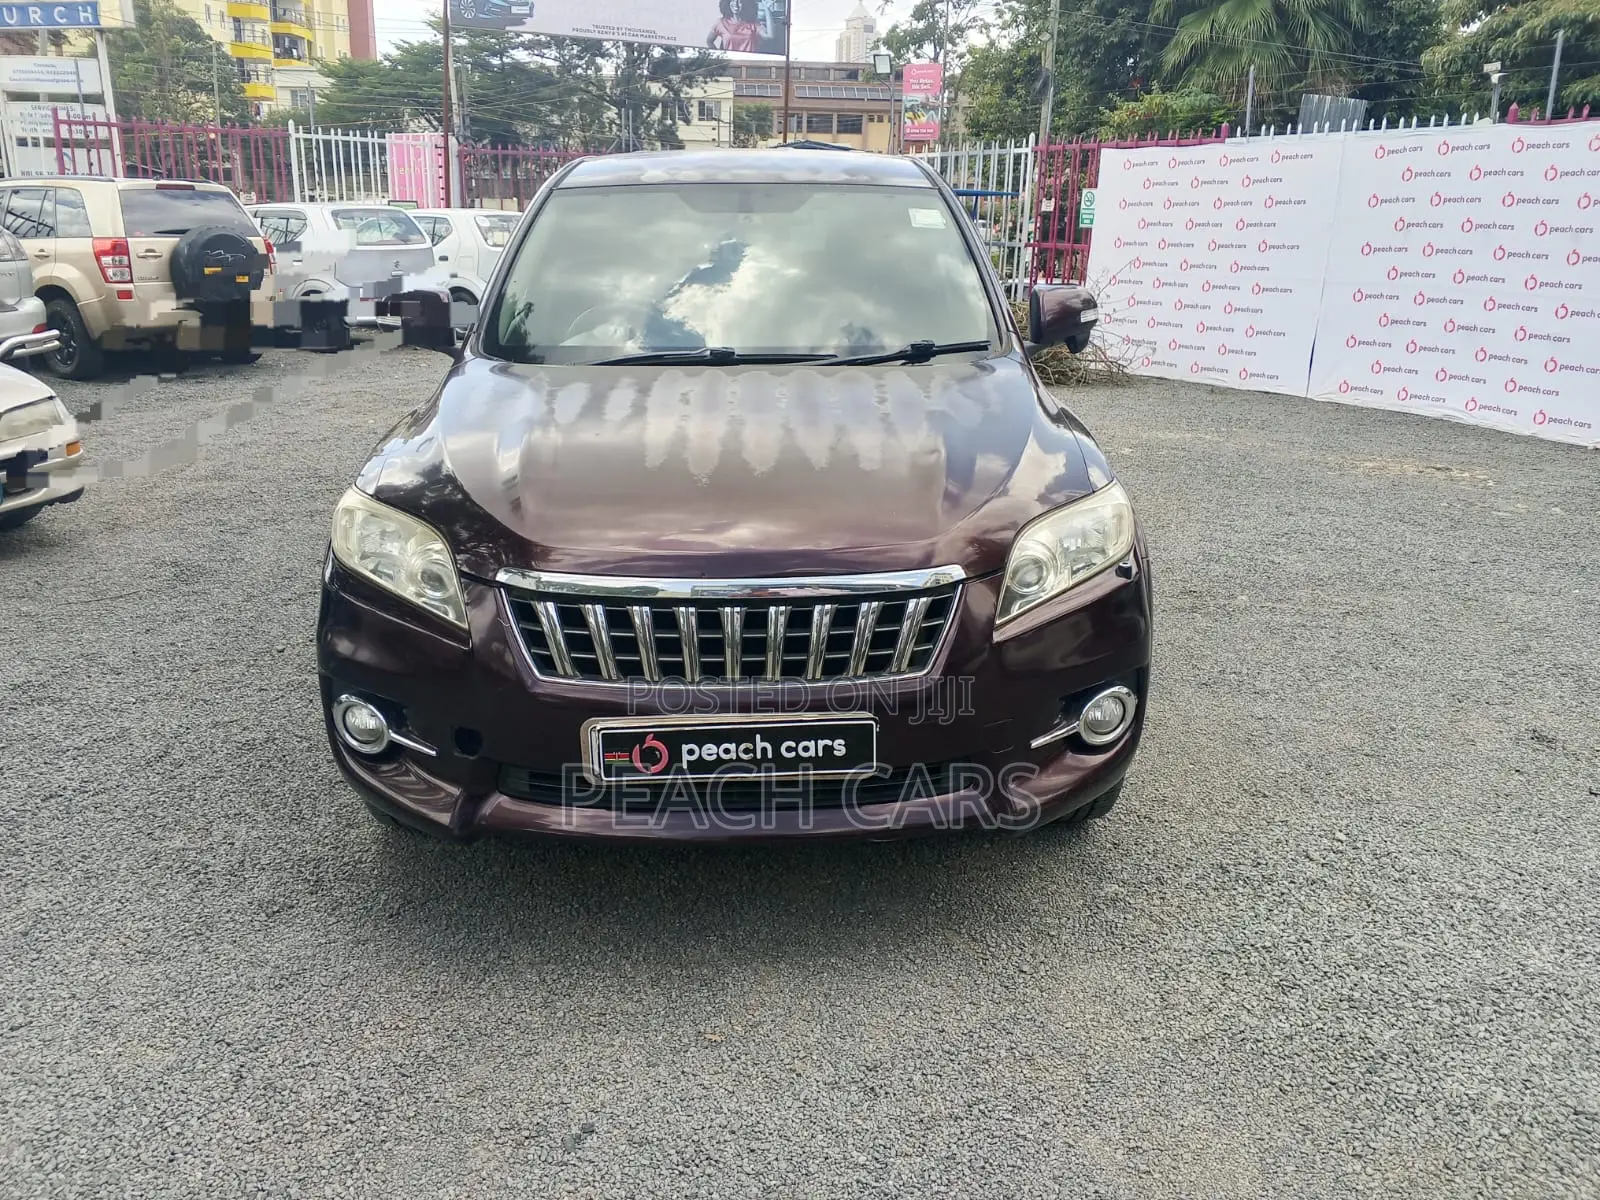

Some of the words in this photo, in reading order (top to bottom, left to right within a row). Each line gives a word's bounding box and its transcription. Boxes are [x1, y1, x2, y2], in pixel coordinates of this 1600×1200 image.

[1450, 143, 1473, 153] peach
[1526, 140, 1550, 151] peach
[1387, 145, 1407, 156] peach
[1229, 156, 1246, 165] peach
[1281, 152, 1299, 161] peach
[1414, 169, 1435, 179] peach
[1483, 167, 1506, 178] peach
[1560, 167, 1585, 179] peach
[1200, 178, 1216, 186] peach
[1252, 175, 1269, 186] peach
[1172, 199, 1187, 208] peach
[1223, 199, 1240, 207] peach
[1275, 198, 1292, 207] peach
[1379, 195, 1400, 206] peach
[1443, 195, 1464, 205] peach
[1516, 196, 1540, 206] peach
[1194, 220, 1210, 228] peach
[1246, 220, 1263, 228] peach
[1406, 220, 1427, 229] peach
[1474, 221, 1497, 232] peach
[1549, 224, 1573, 235] peach
[1218, 242, 1234, 250] peach
[1268, 242, 1286, 250] peach
[1373, 245, 1392, 254] peach
[1435, 247, 1456, 255] peach
[1507, 250, 1530, 259] peach
[1399, 270, 1420, 279] peach
[1466, 274, 1488, 283] peach
[1489, 275, 1506, 283] cars
[1162, 280, 1177, 288] peach
[1539, 280, 1563, 289] peach
[1364, 291, 1384, 300] peach
[1426, 295, 1447, 304] peach
[1497, 302, 1520, 310] peach
[1570, 309, 1596, 318] peach
[1390, 317, 1410, 326] peach
[1456, 323, 1478, 332] peach
[1528, 332, 1551, 341] peach
[1551, 335, 1571, 343] cars
[1357, 338, 1376, 347] peach
[1418, 344, 1439, 352] peach
[1488, 353, 1510, 361] peach
[1511, 356, 1528, 365] cars
[1558, 363, 1584, 372] peach
[1448, 373, 1470, 381] peach
[1470, 376, 1487, 384] cars
[1518, 384, 1541, 394] peach
[1542, 388, 1560, 396] cars
[1478, 403, 1500, 412] peach
[1501, 407, 1518, 416] cars
[1547, 416, 1572, 425] peach
[1573, 420, 1592, 429] cars
[681, 734, 773, 769] peach
[780, 736, 846, 758] cars
